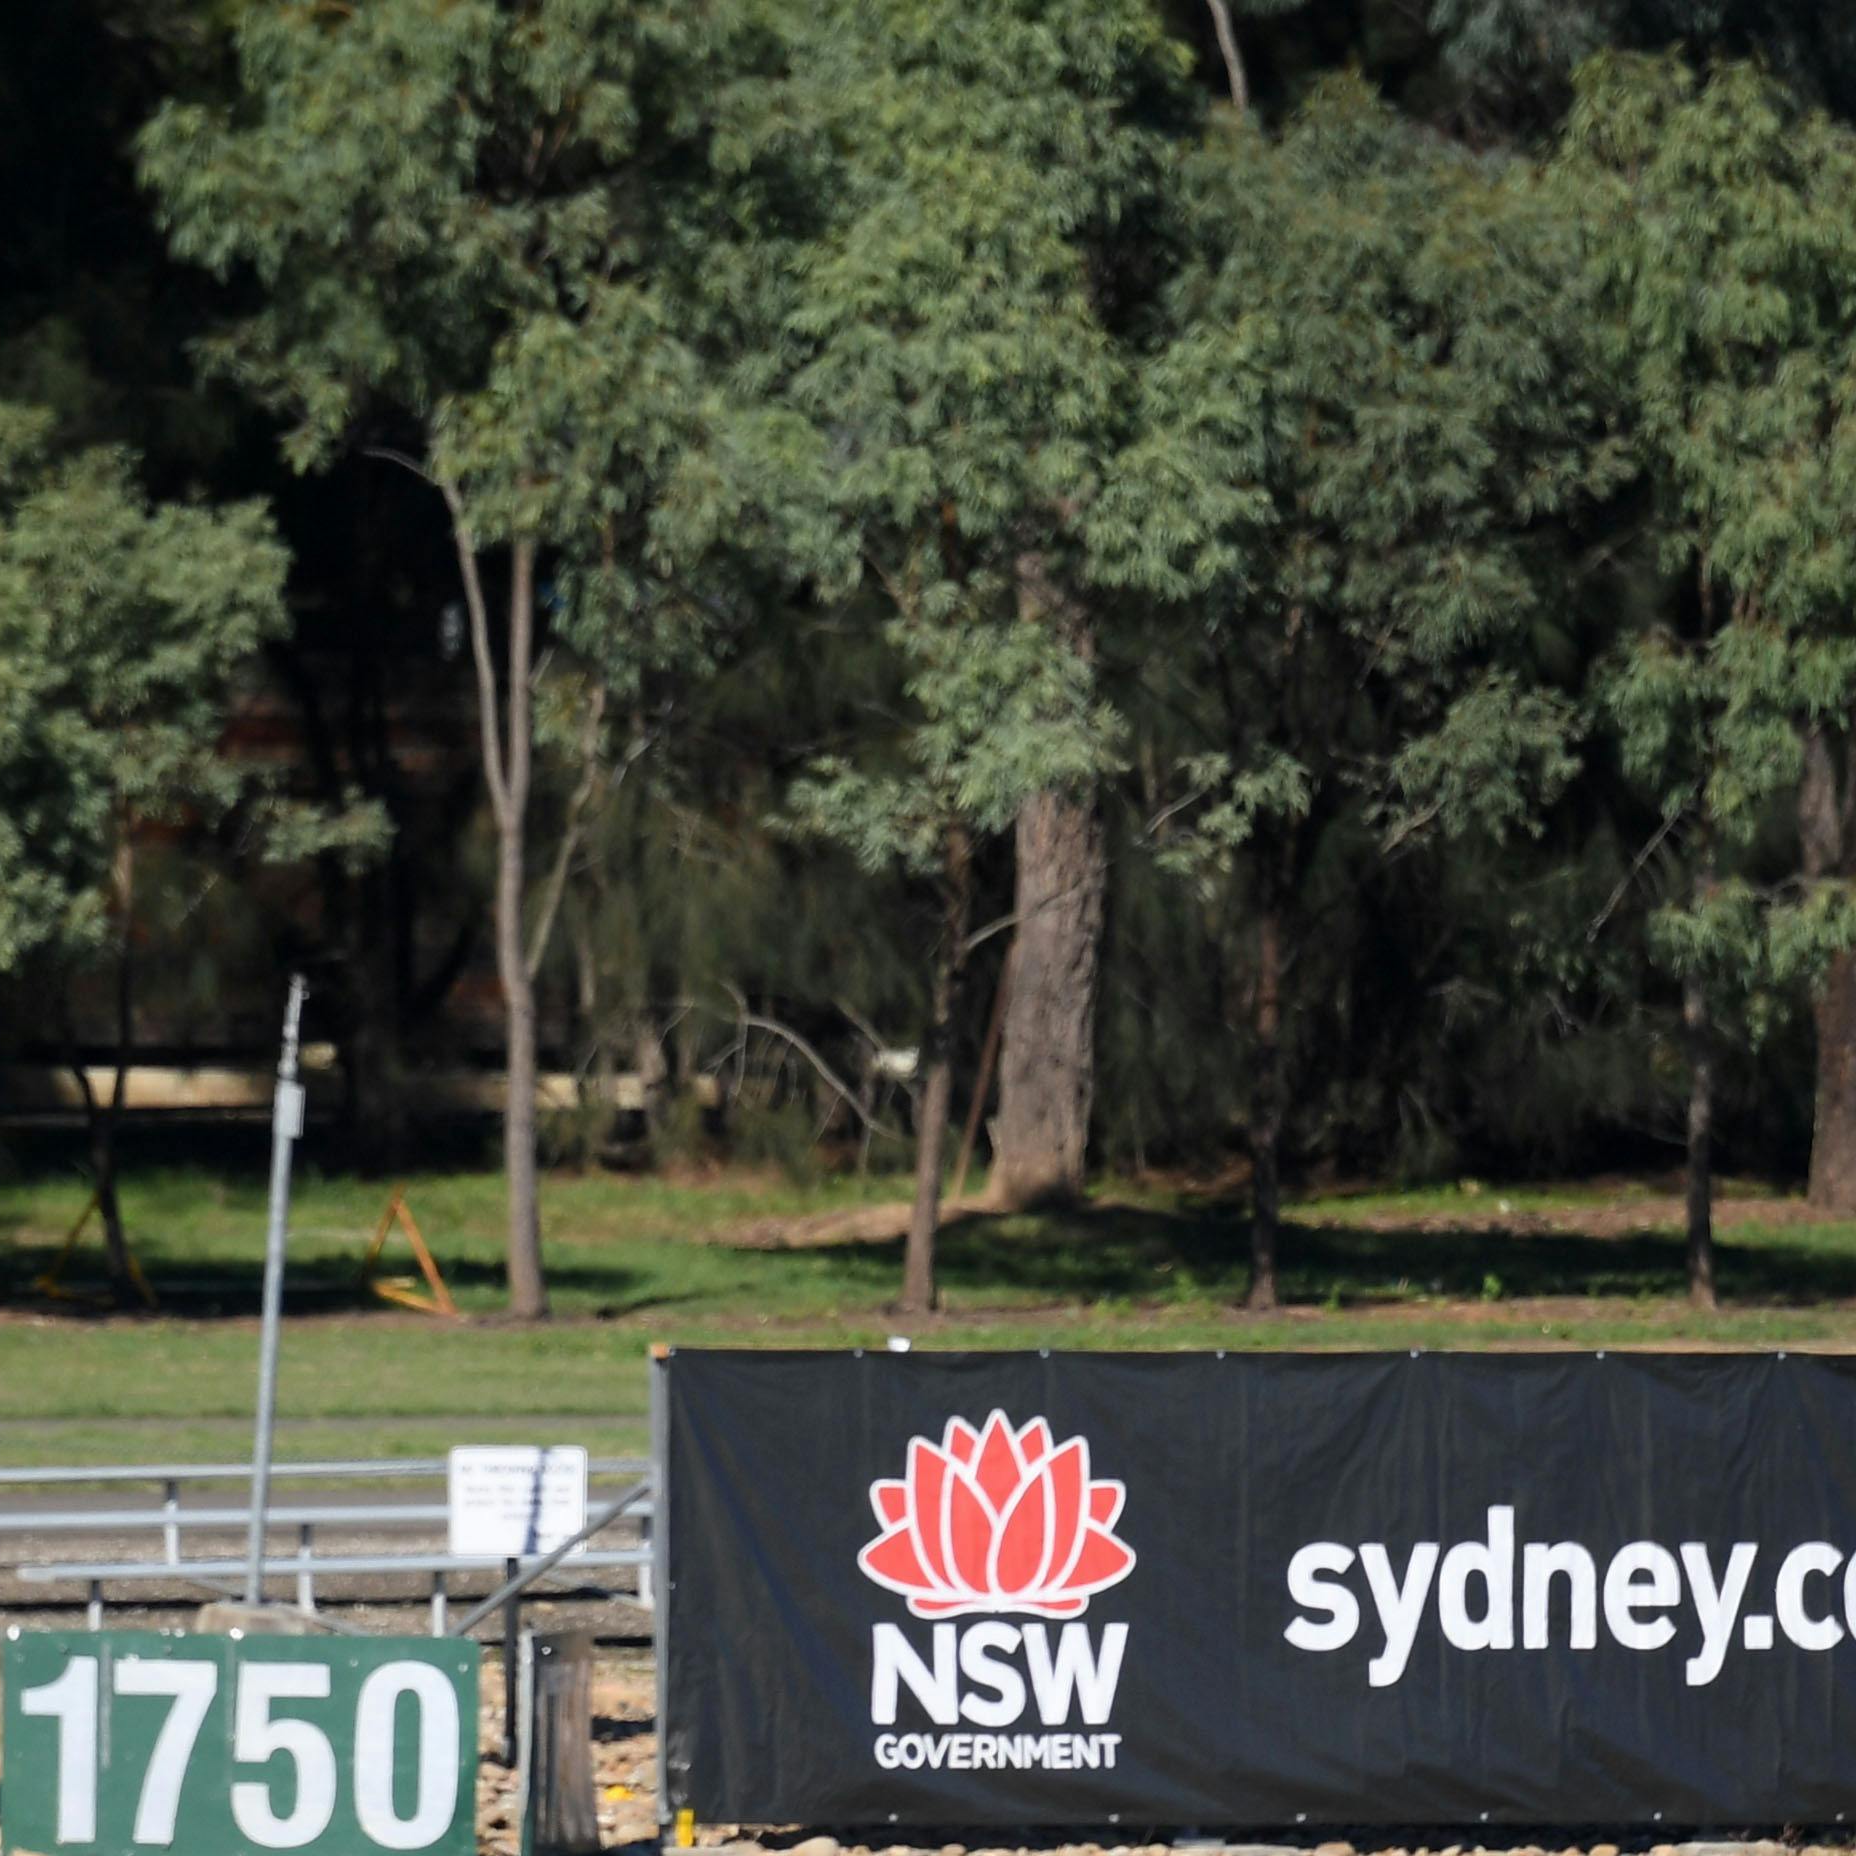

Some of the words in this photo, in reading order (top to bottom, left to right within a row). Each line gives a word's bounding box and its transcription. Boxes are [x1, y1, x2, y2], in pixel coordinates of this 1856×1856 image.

[871, 1621, 1130, 1727] NSW
[20, 1656, 460, 1850] 1750
[874, 1733, 1122, 1770] GOVERNMENT
